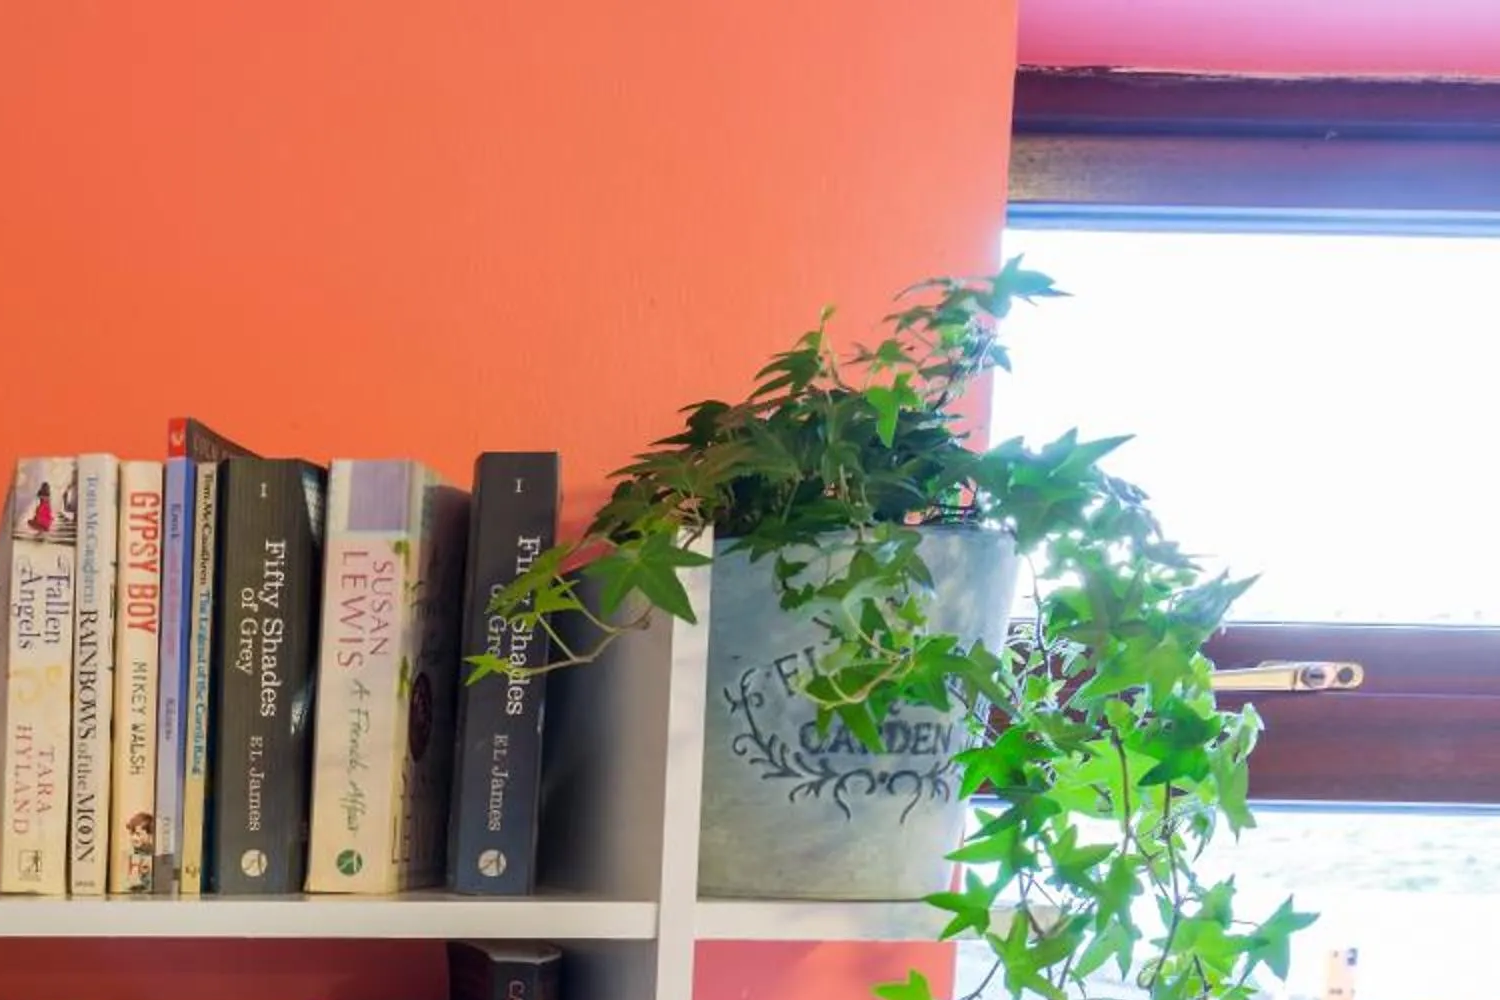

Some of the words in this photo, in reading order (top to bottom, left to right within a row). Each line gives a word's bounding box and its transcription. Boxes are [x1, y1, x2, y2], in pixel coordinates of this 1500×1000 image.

[128, 490, 161, 576] GYPSY
[13, 554, 44, 650] Angels
[43, 555, 71, 645] Fallen
[241, 587, 259, 613] of
[258, 539, 287, 609] Fifty
[369, 560, 395, 657] SUSAN
[125, 583, 160, 636] BOY
[336, 550, 370, 669] LEWIS
[487, 614, 508, 658] Gre
[77, 609, 99, 741] RAINBOWS
[235, 617, 259, 675] Grey
[259, 617, 284, 718] Shades
[505, 616, 534, 716] Shades
[131, 660, 148, 715] MIKEY
[352, 678, 371, 698] A
[128, 723, 147, 777] WALSH
[799, 719, 953, 756] GADEN
[12, 723, 34, 835] HYLAND
[35, 745, 56, 815] TARA
[76, 761, 94, 791] the
[248, 767, 265, 832] James
[487, 766, 509, 832] James
[75, 793, 97, 863] MOON
